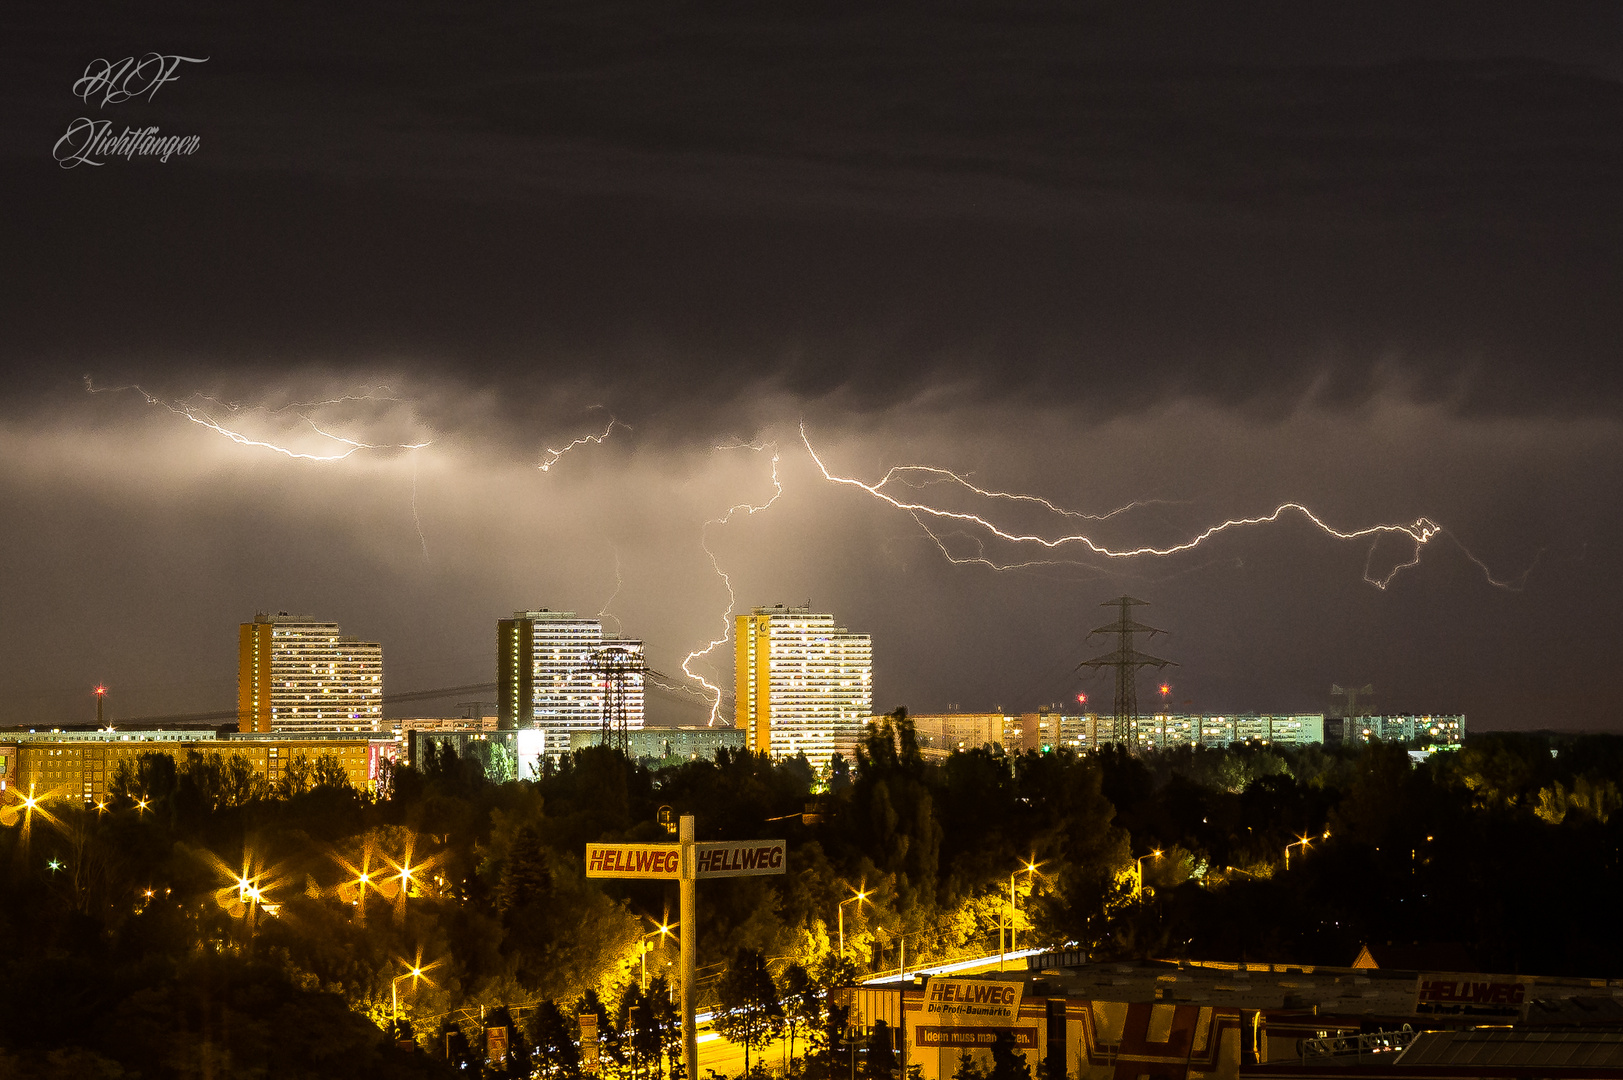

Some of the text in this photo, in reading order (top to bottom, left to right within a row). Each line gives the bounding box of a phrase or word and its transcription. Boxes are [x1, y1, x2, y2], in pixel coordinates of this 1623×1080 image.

[589, 850, 679, 873] HELLWEG
[697, 846, 783, 873] HELLWEG
[930, 983, 1016, 1005] HELLWEG
[1419, 980, 1526, 1004] HELLWEG
[927, 1003, 1012, 1017] Die Profi-Baumärkte
[924, 1029, 949, 1042] Ideen
[951, 1032, 975, 1042] muss
[977, 1032, 997, 1043] man
